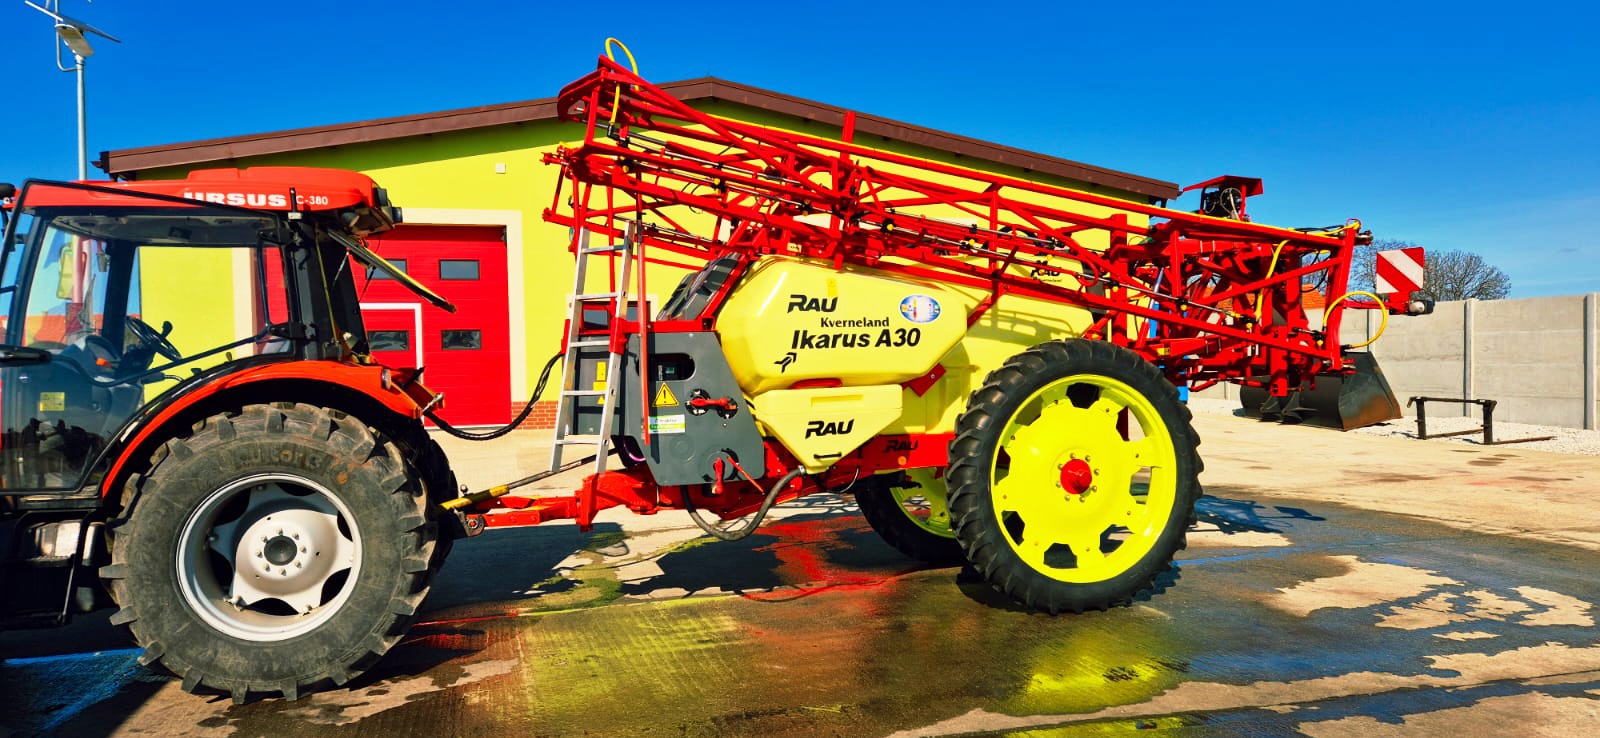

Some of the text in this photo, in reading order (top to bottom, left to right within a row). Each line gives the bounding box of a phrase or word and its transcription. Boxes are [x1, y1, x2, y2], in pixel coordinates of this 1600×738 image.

[184, 192, 329, 207] URSUS C-380
[787, 294, 838, 313] RAU
[820, 317, 889, 328] Kverneland
[791, 328, 921, 349] Ikarus A30
[805, 418, 855, 439] RAU
[885, 439, 918, 453] RAU
